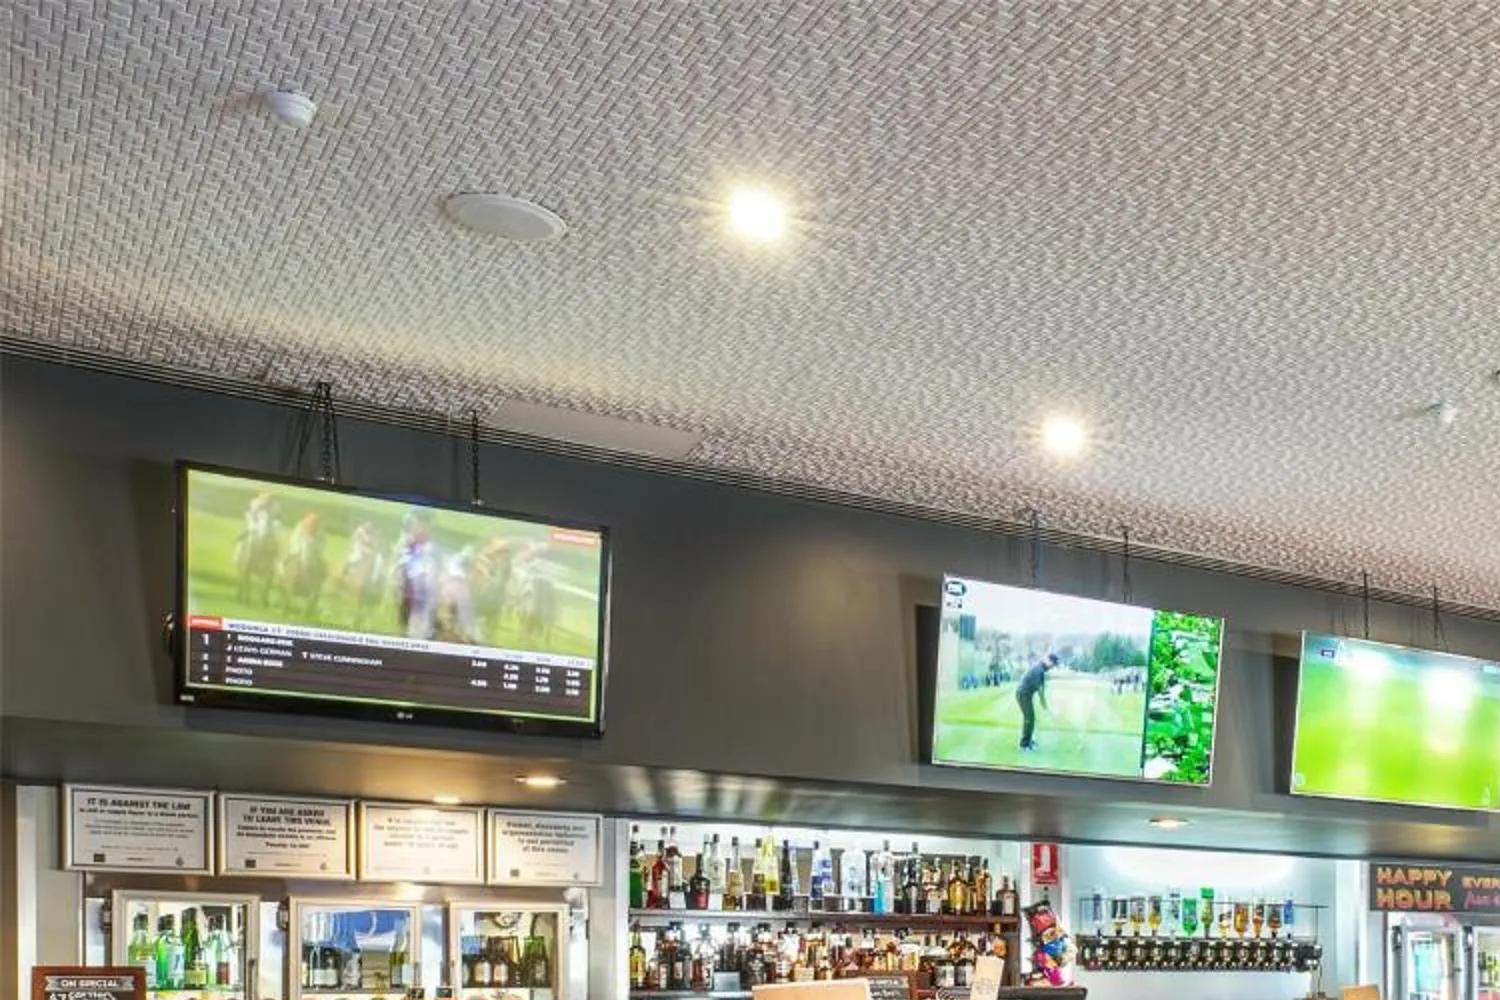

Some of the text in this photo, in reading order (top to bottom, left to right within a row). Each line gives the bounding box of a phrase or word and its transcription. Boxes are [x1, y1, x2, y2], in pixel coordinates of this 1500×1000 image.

[1376, 867, 1453, 887] HAPPY
[1376, 888, 1451, 910] HOUR
[61, 979, 118, 988] ON SPECIAL
